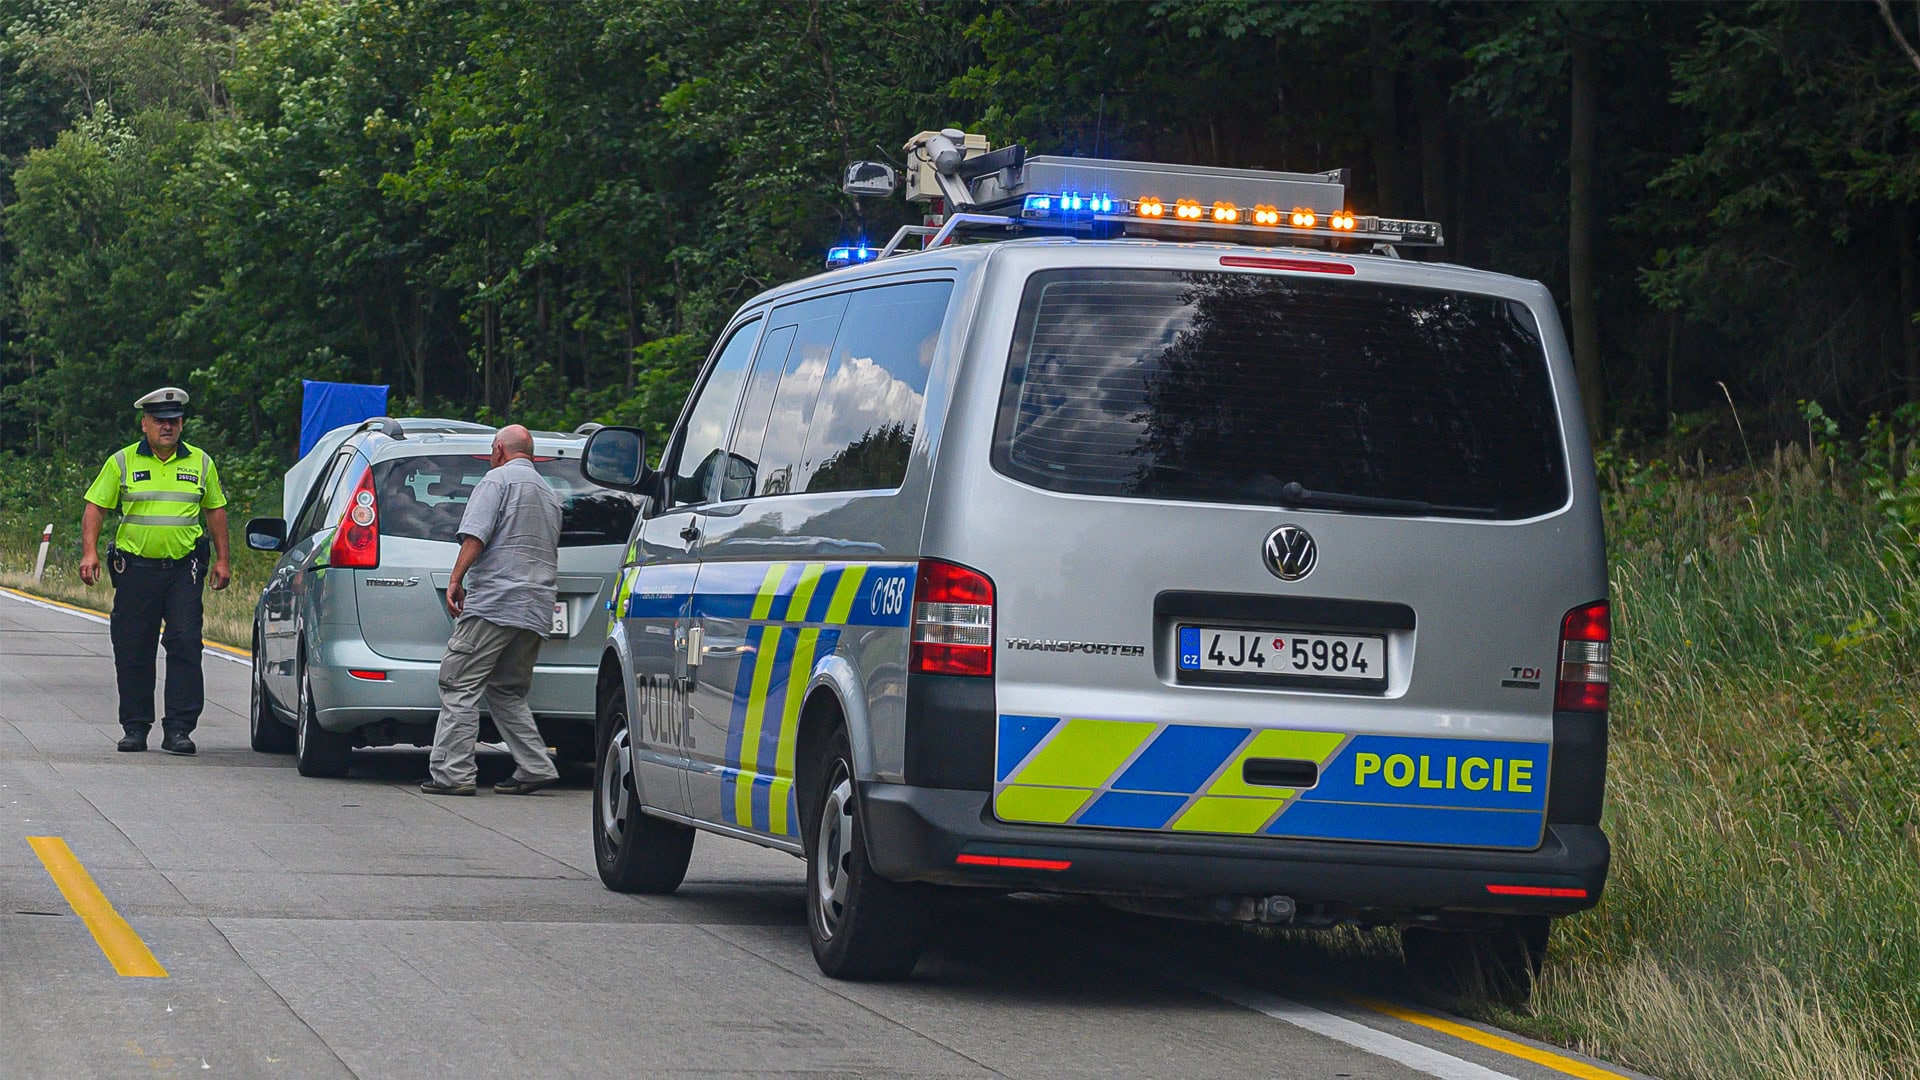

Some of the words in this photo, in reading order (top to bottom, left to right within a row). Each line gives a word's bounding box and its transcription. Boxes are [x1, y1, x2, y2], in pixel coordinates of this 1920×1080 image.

[882, 577, 906, 615] 158
[1005, 637, 1145, 657] TRANSPORTER
[1183, 654, 1198, 665] CZ
[1207, 634, 1265, 668] 4J4
[1292, 638, 1368, 673] 5984
[1511, 667, 1541, 679] TDI
[640, 673, 696, 749] POLICIE
[1355, 752, 1533, 793] POLICIE
